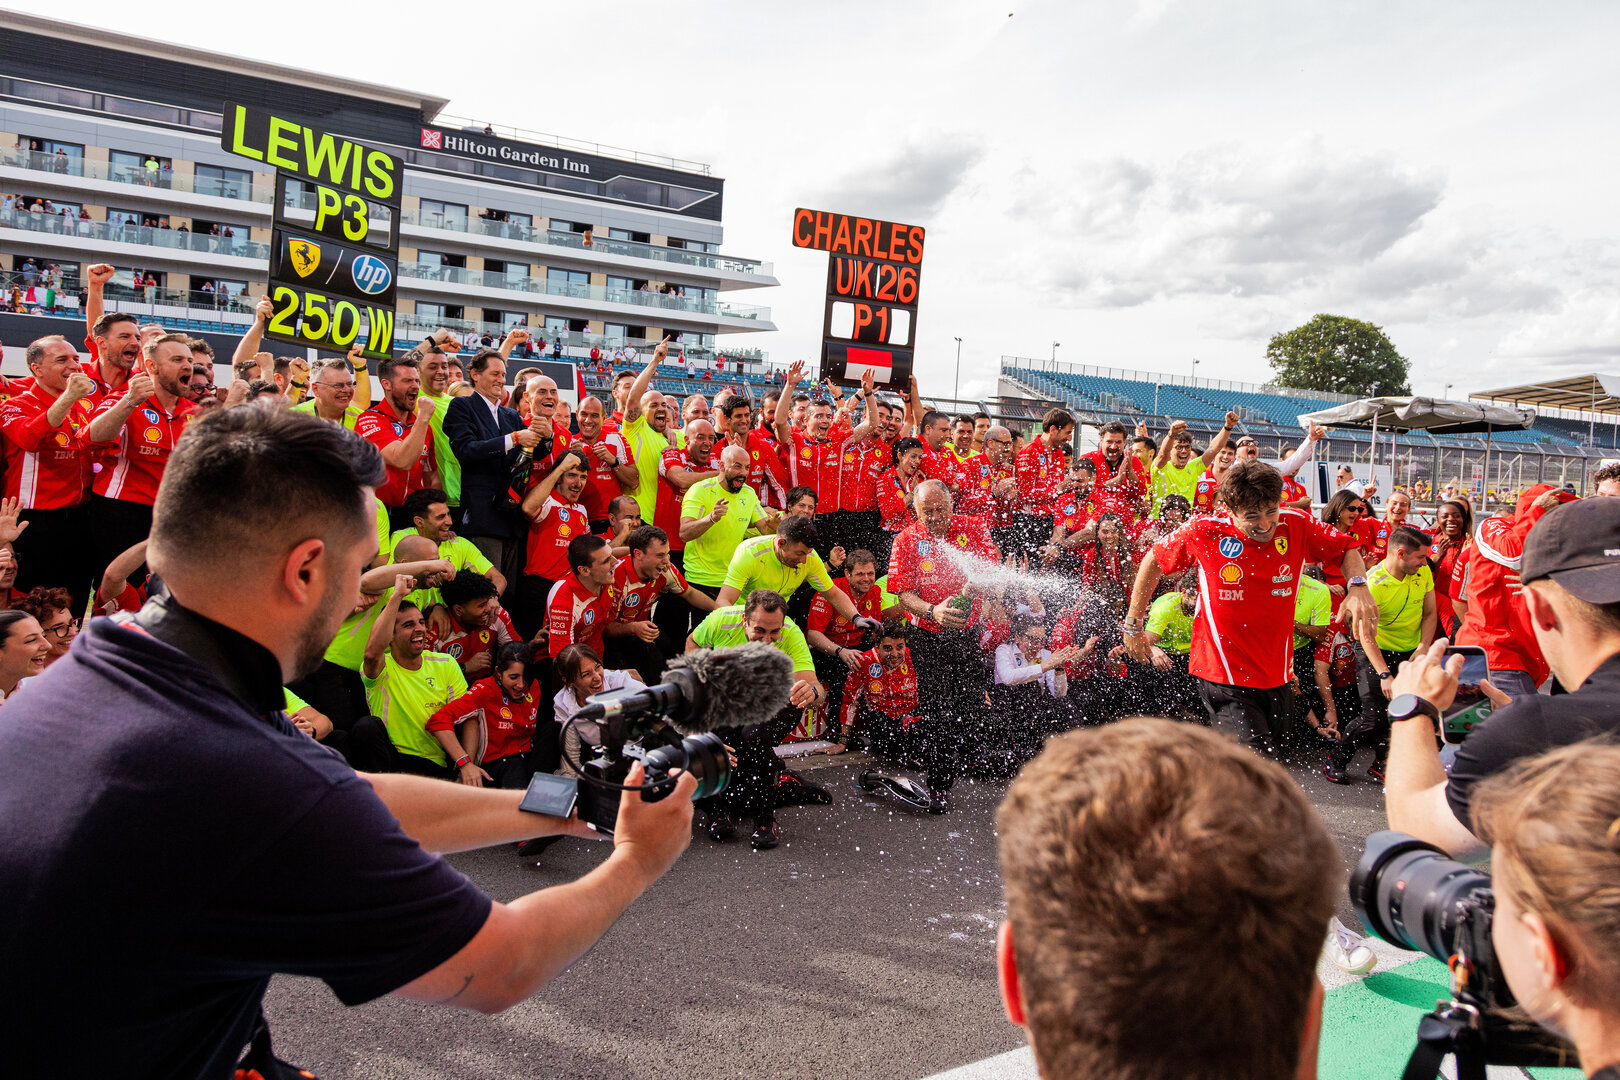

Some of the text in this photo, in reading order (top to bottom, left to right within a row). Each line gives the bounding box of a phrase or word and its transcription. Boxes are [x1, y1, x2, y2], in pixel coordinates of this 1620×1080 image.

[233, 104, 395, 199] LEWIS
[444, 136, 590, 174] Hilton Garden Inn
[315, 185, 369, 242] P3
[794, 208, 925, 264] CHARLES
[357, 256, 387, 293] hp
[853, 303, 889, 343] P1
[54, 450, 75, 460] IBM
[138, 445, 160, 456] IBM
[533, 462, 546, 470] BM
[1371, 495, 1381, 505] ns
[559, 508, 570, 522] hp
[1222, 537, 1242, 557] hp
[626, 593, 639, 607] hp
[1218, 589, 1245, 601] IBM
[584, 609, 594, 625] hp
[447, 645, 462, 660] hp
[870, 663, 882, 678] hp
[498, 721, 514, 730] IBM
